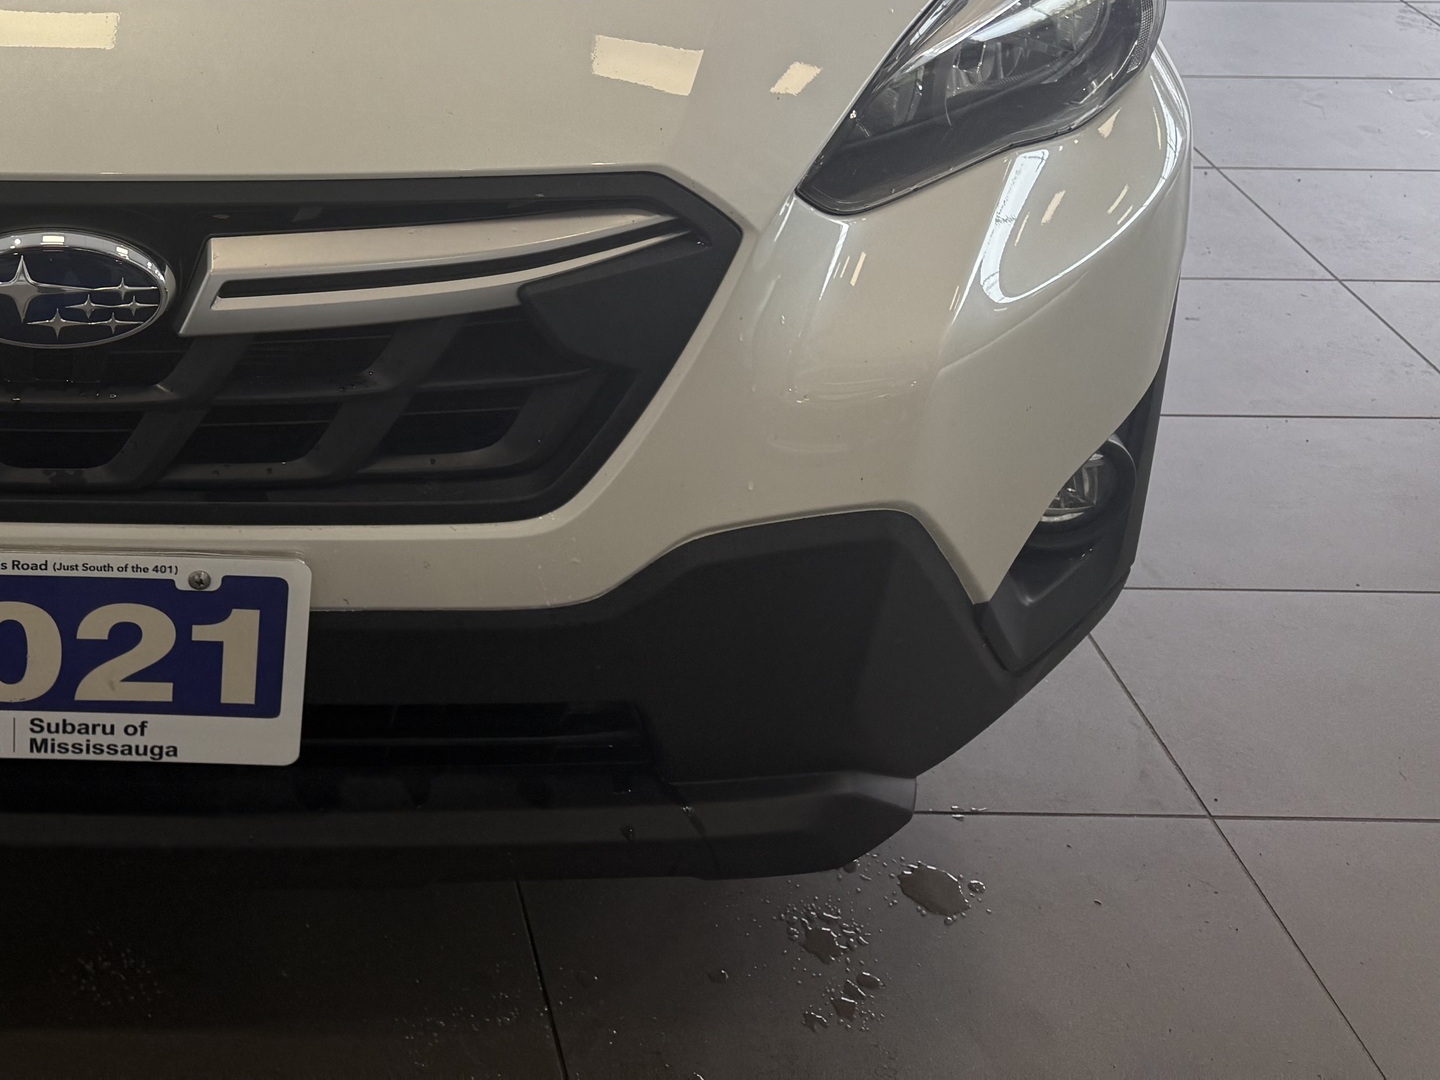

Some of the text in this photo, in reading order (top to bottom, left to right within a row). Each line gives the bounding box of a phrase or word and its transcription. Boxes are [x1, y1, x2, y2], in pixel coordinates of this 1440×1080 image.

[12, 559, 49, 571] Road
[52, 561, 79, 573] (Just
[81, 562, 114, 573] South
[116, 563, 129, 573] of
[131, 563, 150, 574] the
[152, 563, 179, 576] 401)
[28, 718, 149, 737] Subaru of
[29, 738, 179, 760] Mississauga
